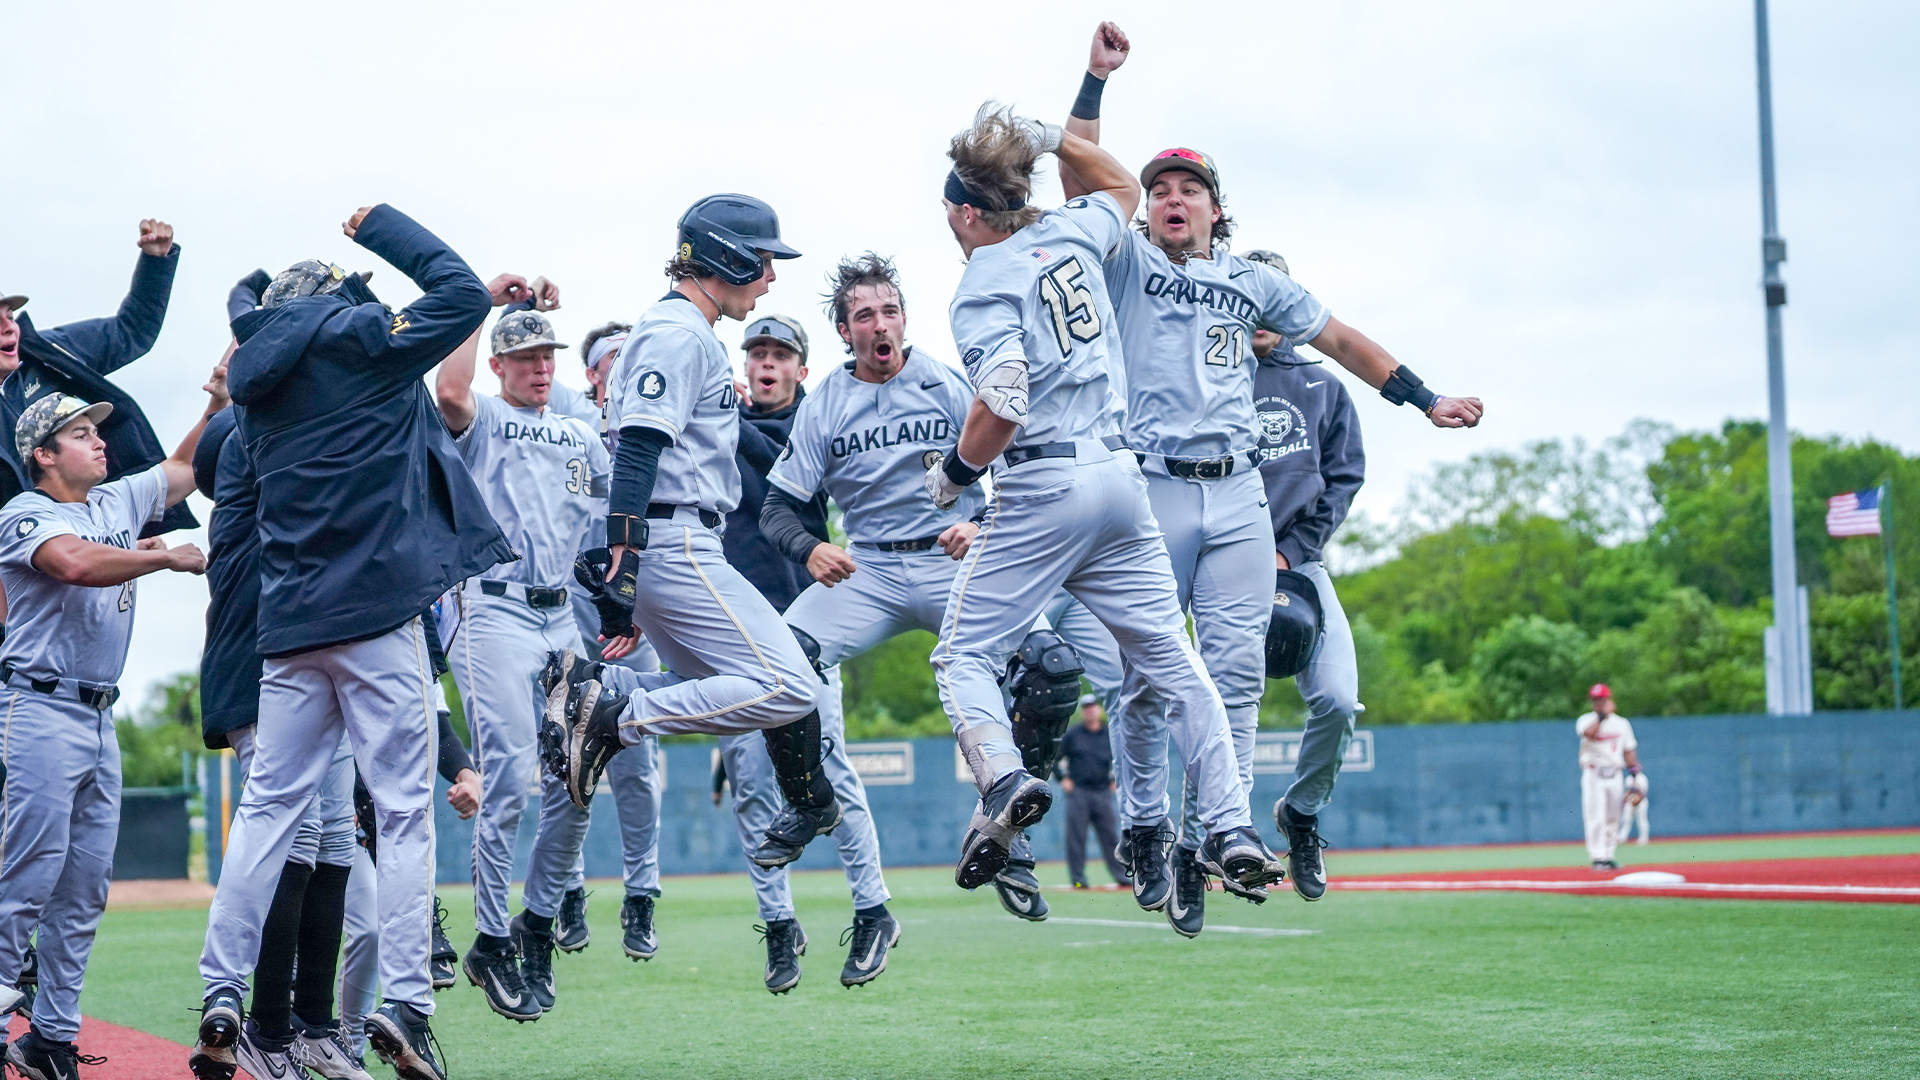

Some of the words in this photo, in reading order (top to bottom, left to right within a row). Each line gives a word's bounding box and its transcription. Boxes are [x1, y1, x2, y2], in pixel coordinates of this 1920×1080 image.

[1038, 253, 1102, 359] 15
[1144, 272, 1255, 320] OAKLAND
[1205, 324, 1244, 369] 21
[830, 418, 950, 458] OAKLAND
[1260, 438, 1311, 460] SEBALL
